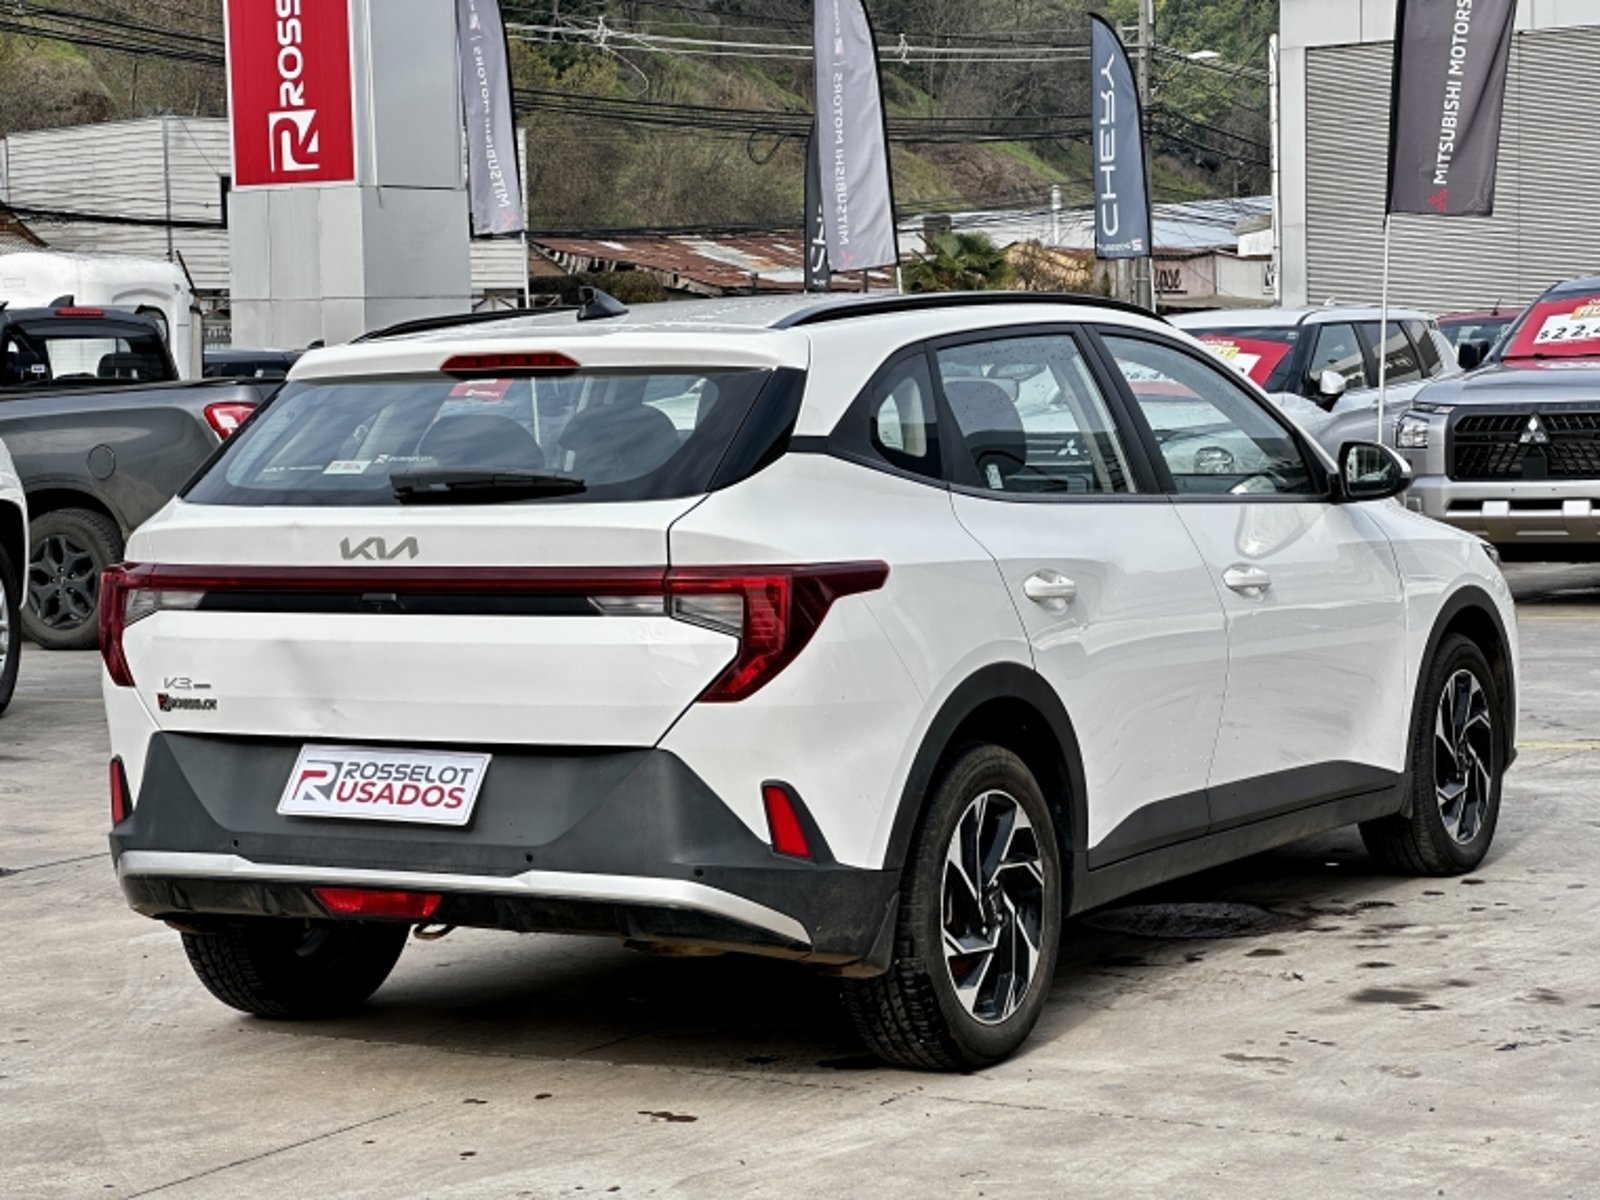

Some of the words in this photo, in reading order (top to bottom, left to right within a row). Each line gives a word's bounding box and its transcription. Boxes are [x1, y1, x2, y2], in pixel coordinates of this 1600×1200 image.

[1447, 0, 1473, 75] MOTORS
[1433, 80, 1462, 184] MITSUBISHI
[340, 536, 419, 560] KIA
[164, 677, 192, 689] K3
[342, 761, 474, 786] ROSSELOT
[336, 780, 465, 809] USADOS
